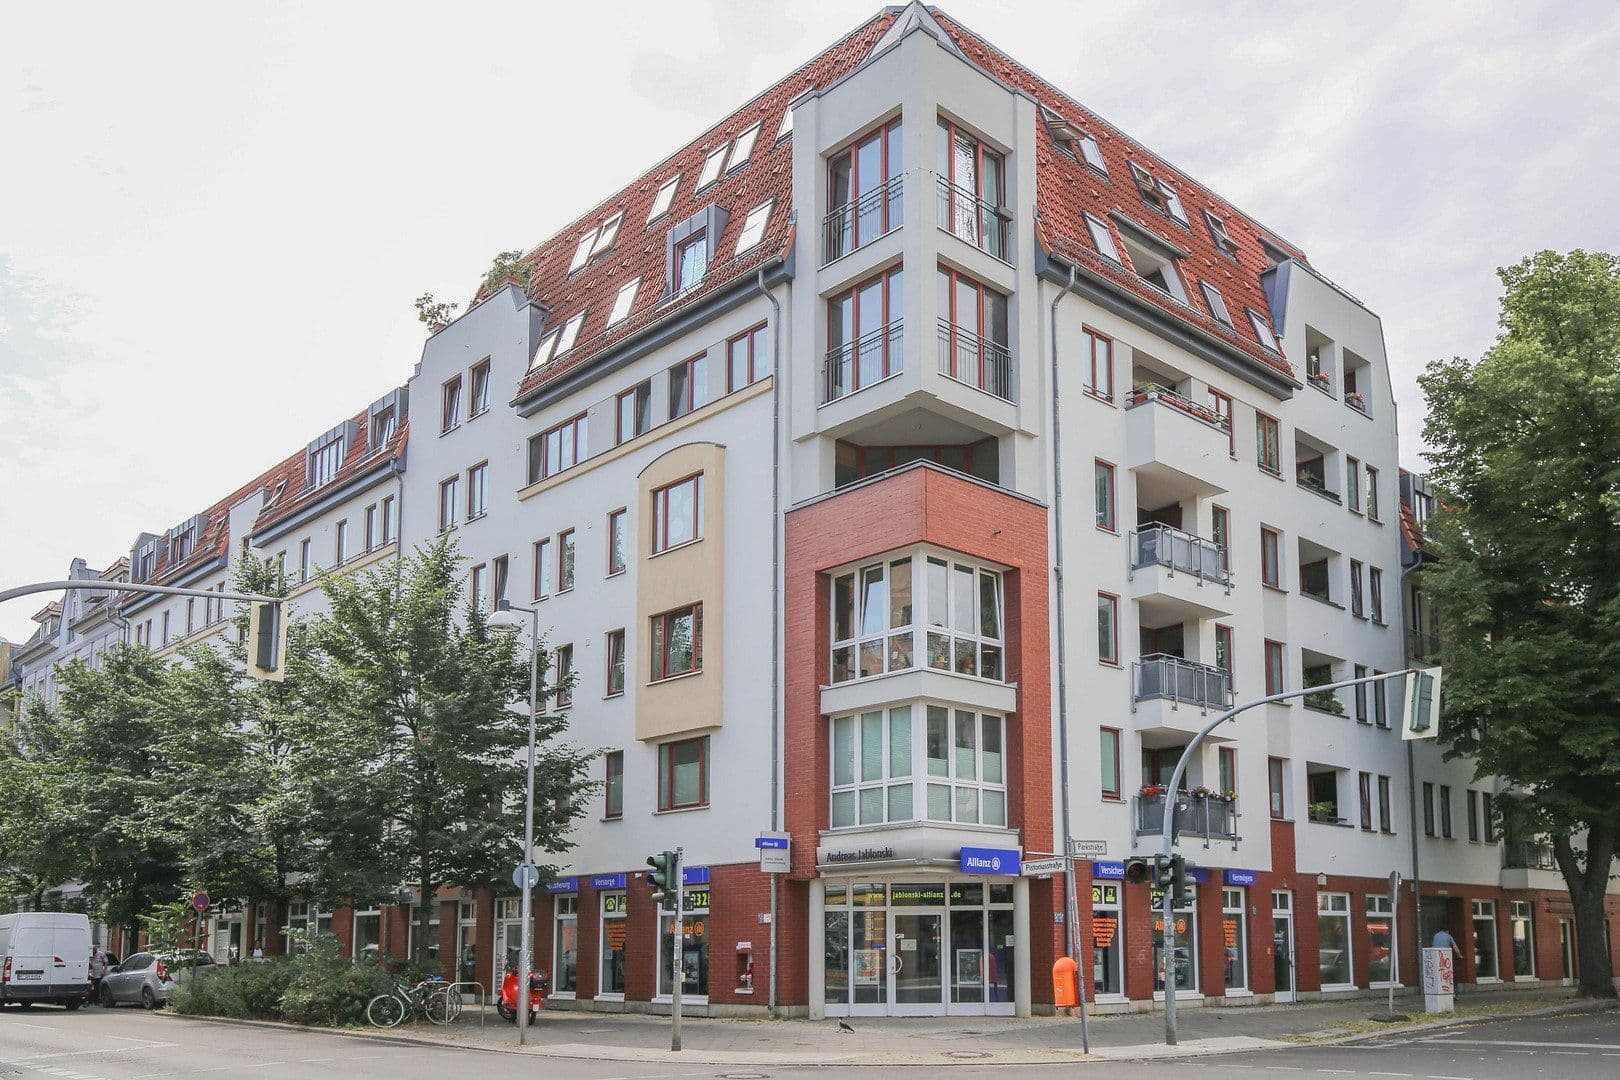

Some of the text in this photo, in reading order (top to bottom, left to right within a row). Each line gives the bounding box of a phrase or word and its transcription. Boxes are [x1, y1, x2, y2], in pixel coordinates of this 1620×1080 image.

[1077, 842, 1104, 852] Parkstraße
[826, 847, 894, 862] Andreas Jablonski
[966, 858, 992, 868] Allianz
[1025, 860, 1063, 872] Pistoriusstraße
[595, 878, 617, 887] Vorsorge
